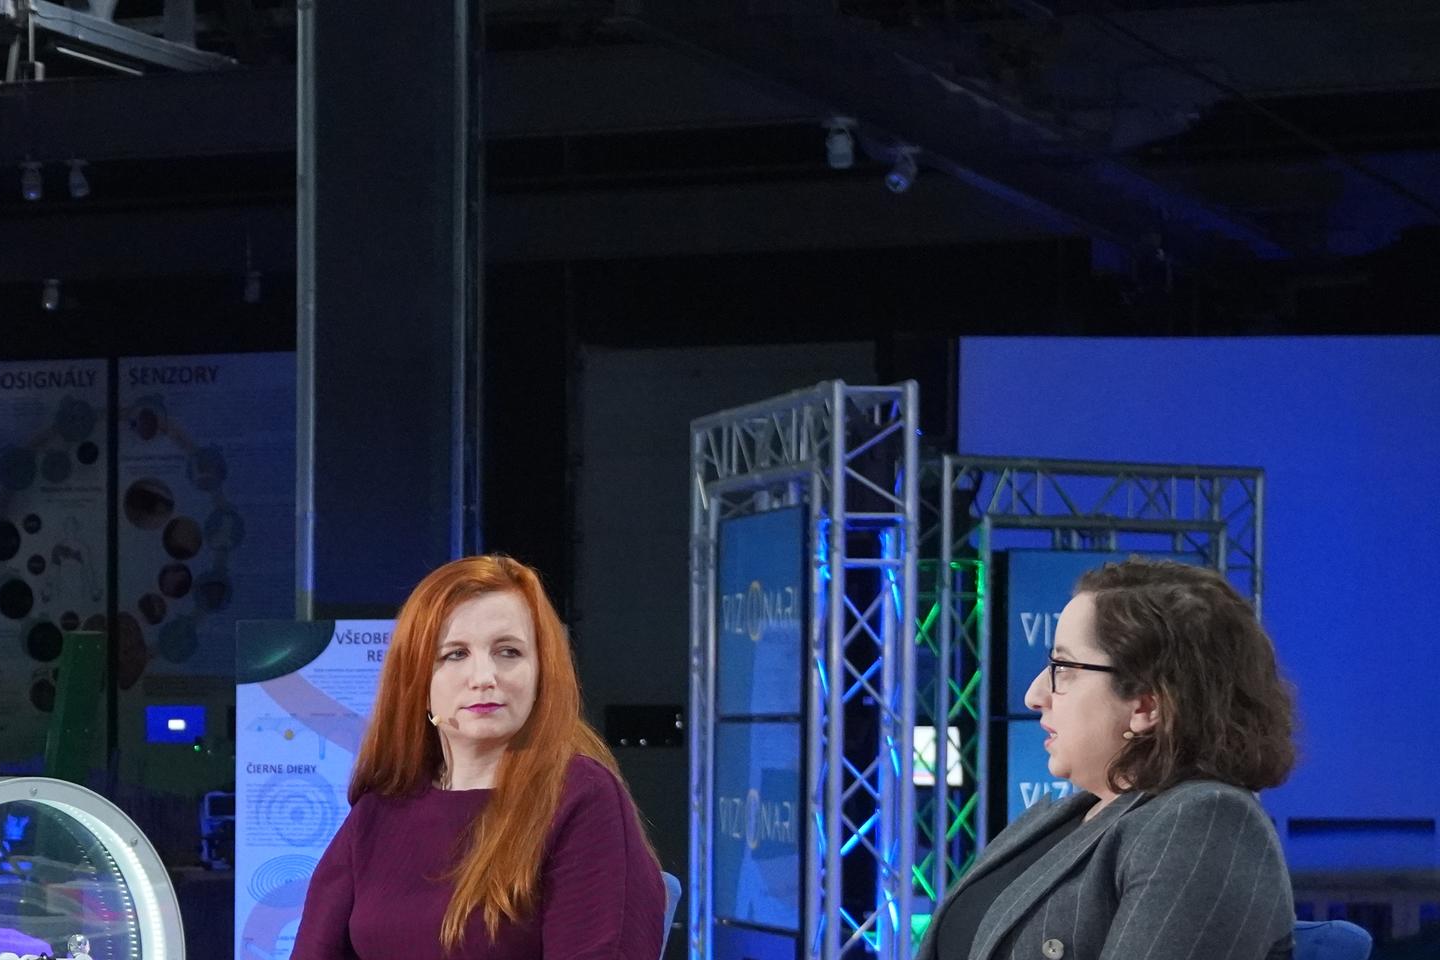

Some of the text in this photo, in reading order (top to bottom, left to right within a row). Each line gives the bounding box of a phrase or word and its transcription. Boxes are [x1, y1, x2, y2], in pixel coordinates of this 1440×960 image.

[128, 365, 220, 386] SENZORY
[335, 629, 393, 645] VŠEOBE
[367, 649, 384, 662] RE
[246, 762, 317, 774] ČIERNE DIERY
